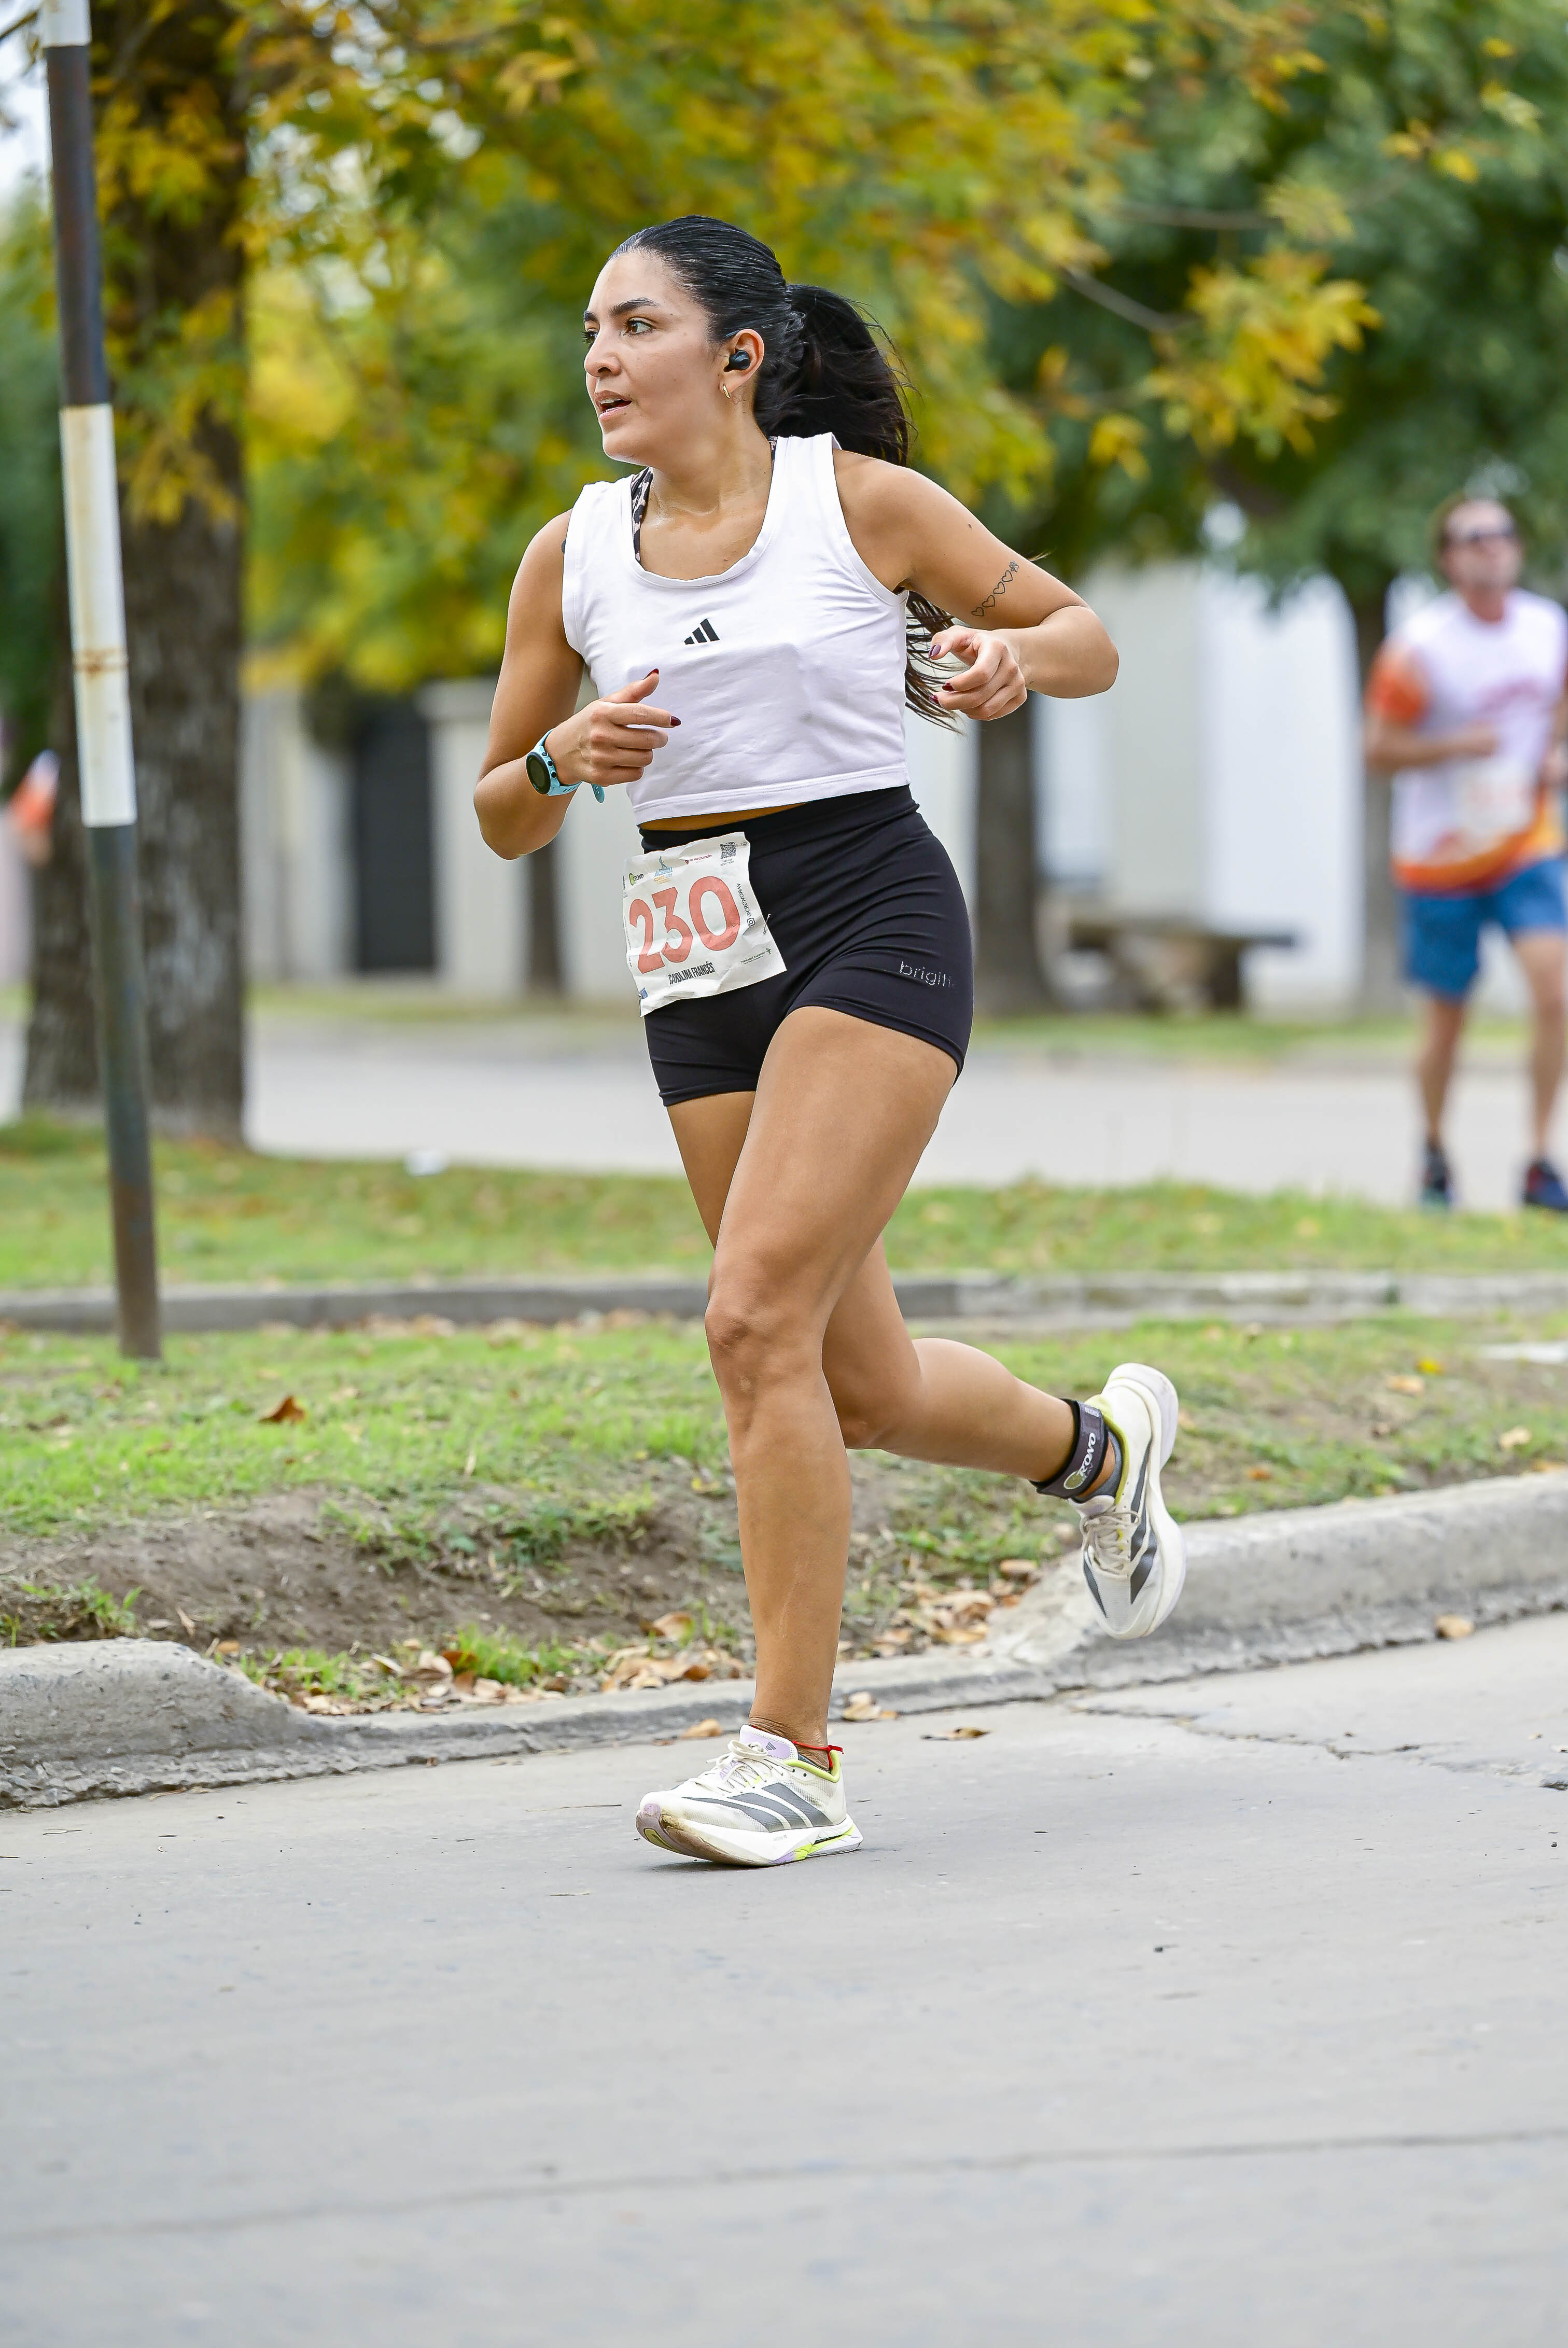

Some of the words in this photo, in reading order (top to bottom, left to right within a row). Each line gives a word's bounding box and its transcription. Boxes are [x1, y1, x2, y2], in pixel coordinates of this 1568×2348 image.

[736, 883, 752, 917] @CRONORAV
[629, 876, 740, 974] 230
[668, 969, 694, 985] CAROLINA
[691, 961, 715, 977] FRANCÉS
